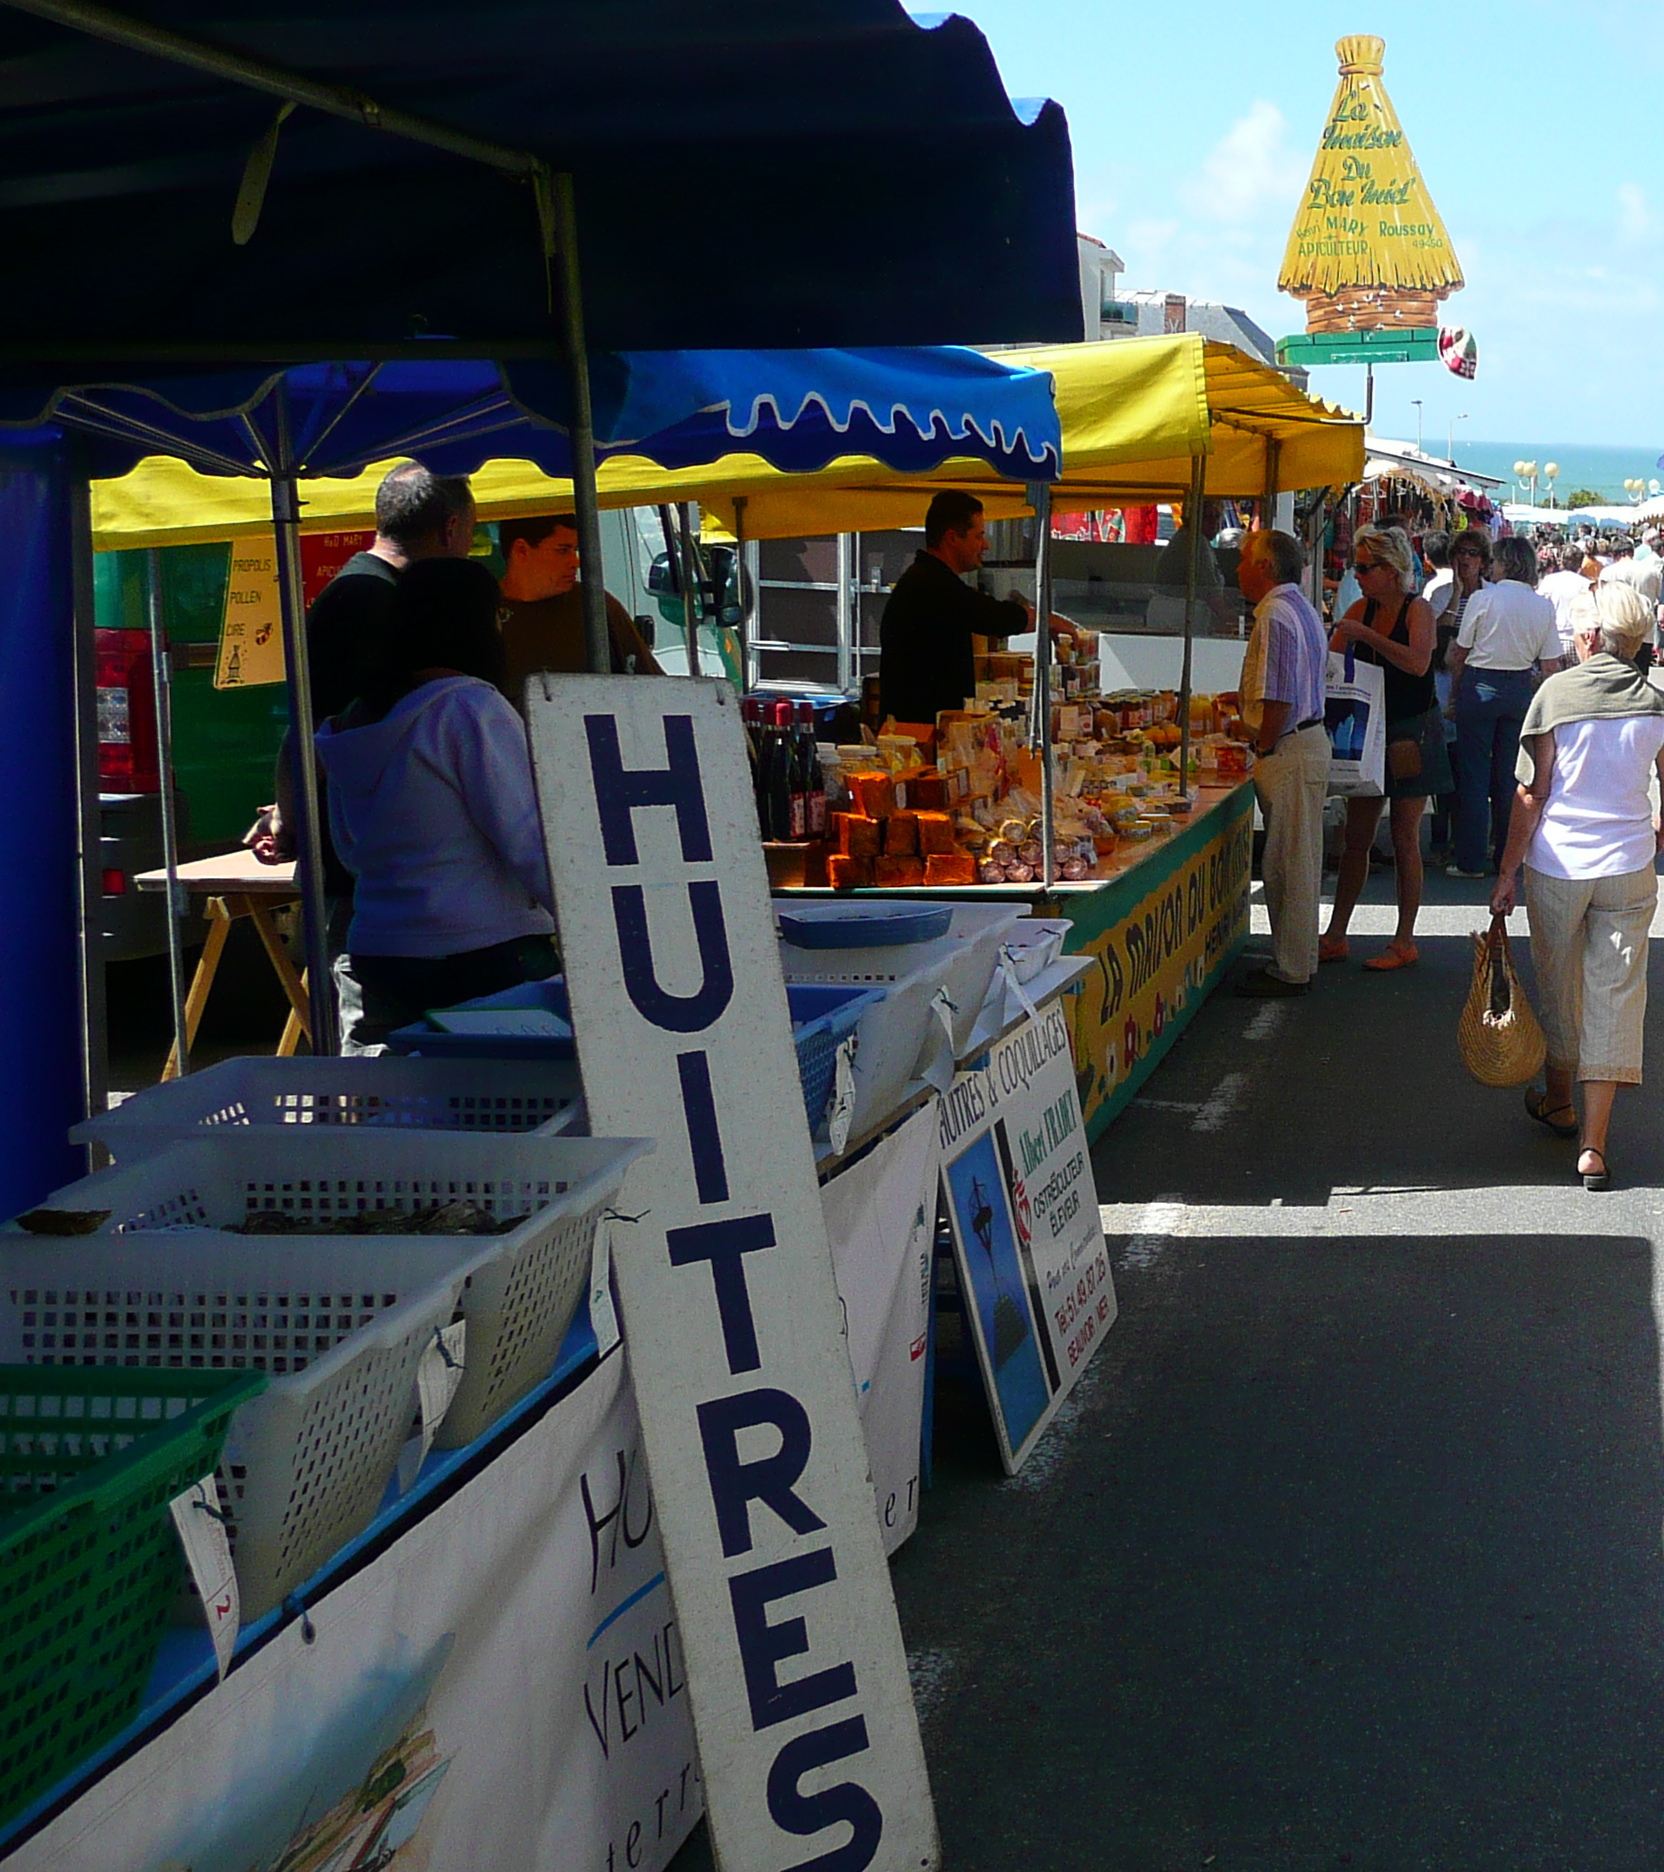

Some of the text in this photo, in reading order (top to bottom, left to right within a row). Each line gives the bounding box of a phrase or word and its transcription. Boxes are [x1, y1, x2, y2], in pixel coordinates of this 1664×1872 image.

[1326, 216, 1368, 237] MARY
[1379, 220, 1434, 238] Roussay
[1298, 240, 1368, 257] APICULTEUR
[233, 558, 272, 572] PROPOLIS
[229, 590, 262, 604] POLLEN
[226, 623, 246, 637] CIRE
[1097, 943, 1124, 1026] LA
[1187, 861, 1206, 937] DU
[998, 1009, 1066, 1095] COQUILLAGES
[1019, 1122, 1048, 1179] Albert
[584, 713, 884, 1872] HUITRES
[606, 1761, 701, 1872] terr
